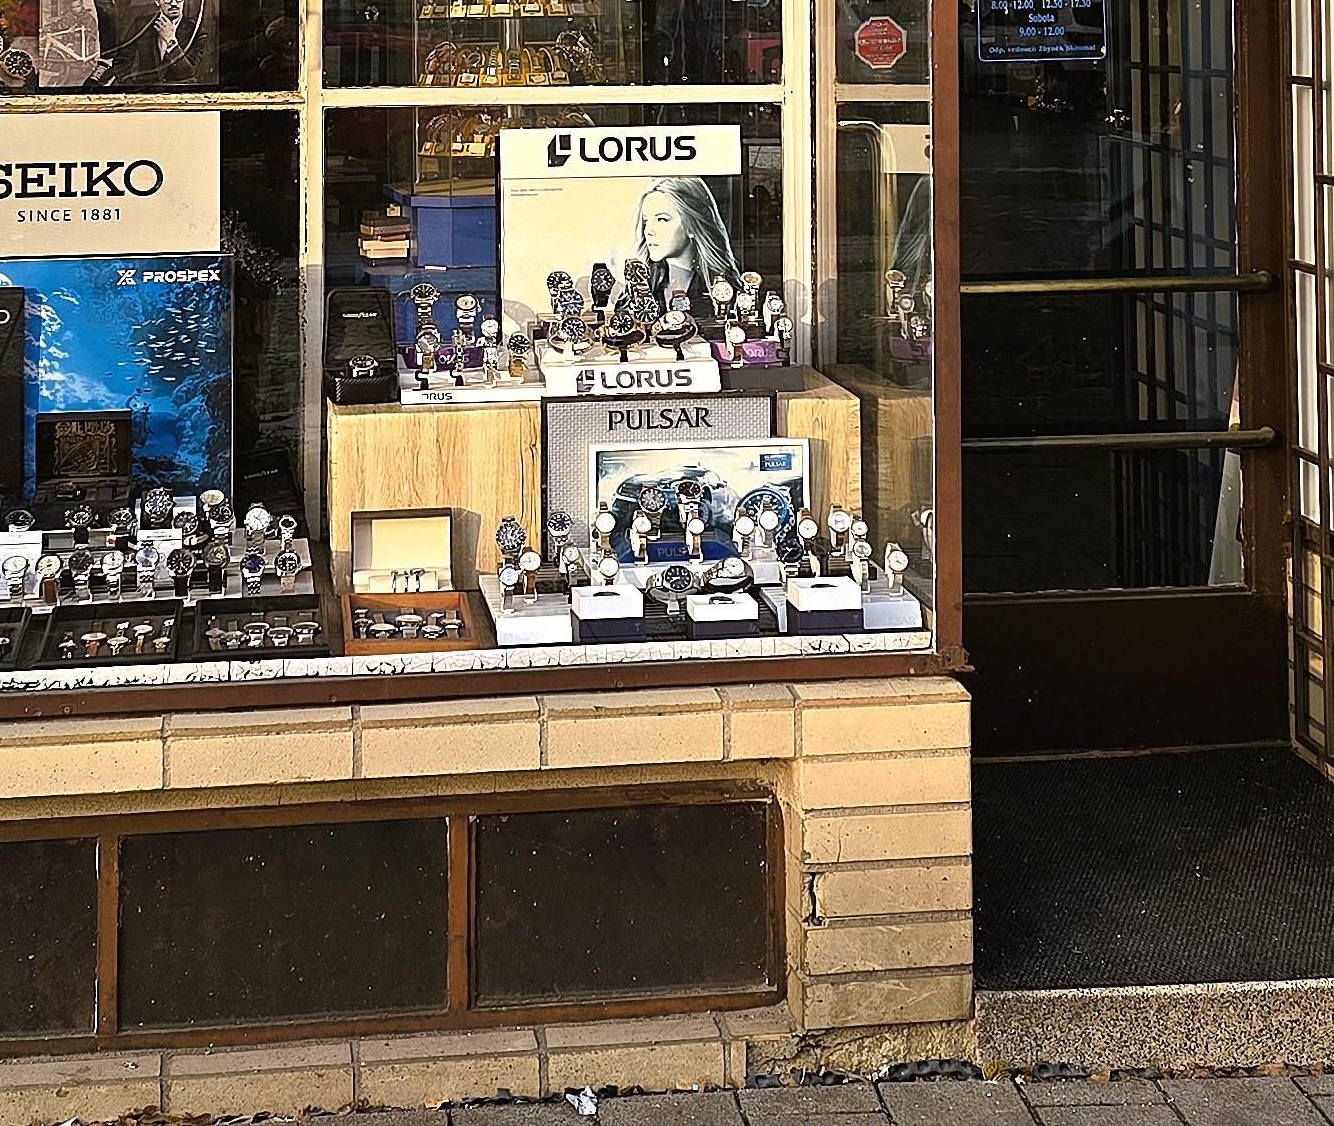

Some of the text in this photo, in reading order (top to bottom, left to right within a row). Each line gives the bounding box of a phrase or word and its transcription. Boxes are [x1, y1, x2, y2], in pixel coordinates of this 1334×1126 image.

[578, 135, 697, 163] LORUS
[17, 208, 122, 223] SINCE 1881
[142, 269, 222, 283] PROSPEX
[599, 368, 694, 391] LORUS
[607, 406, 712, 432] PULSAR
